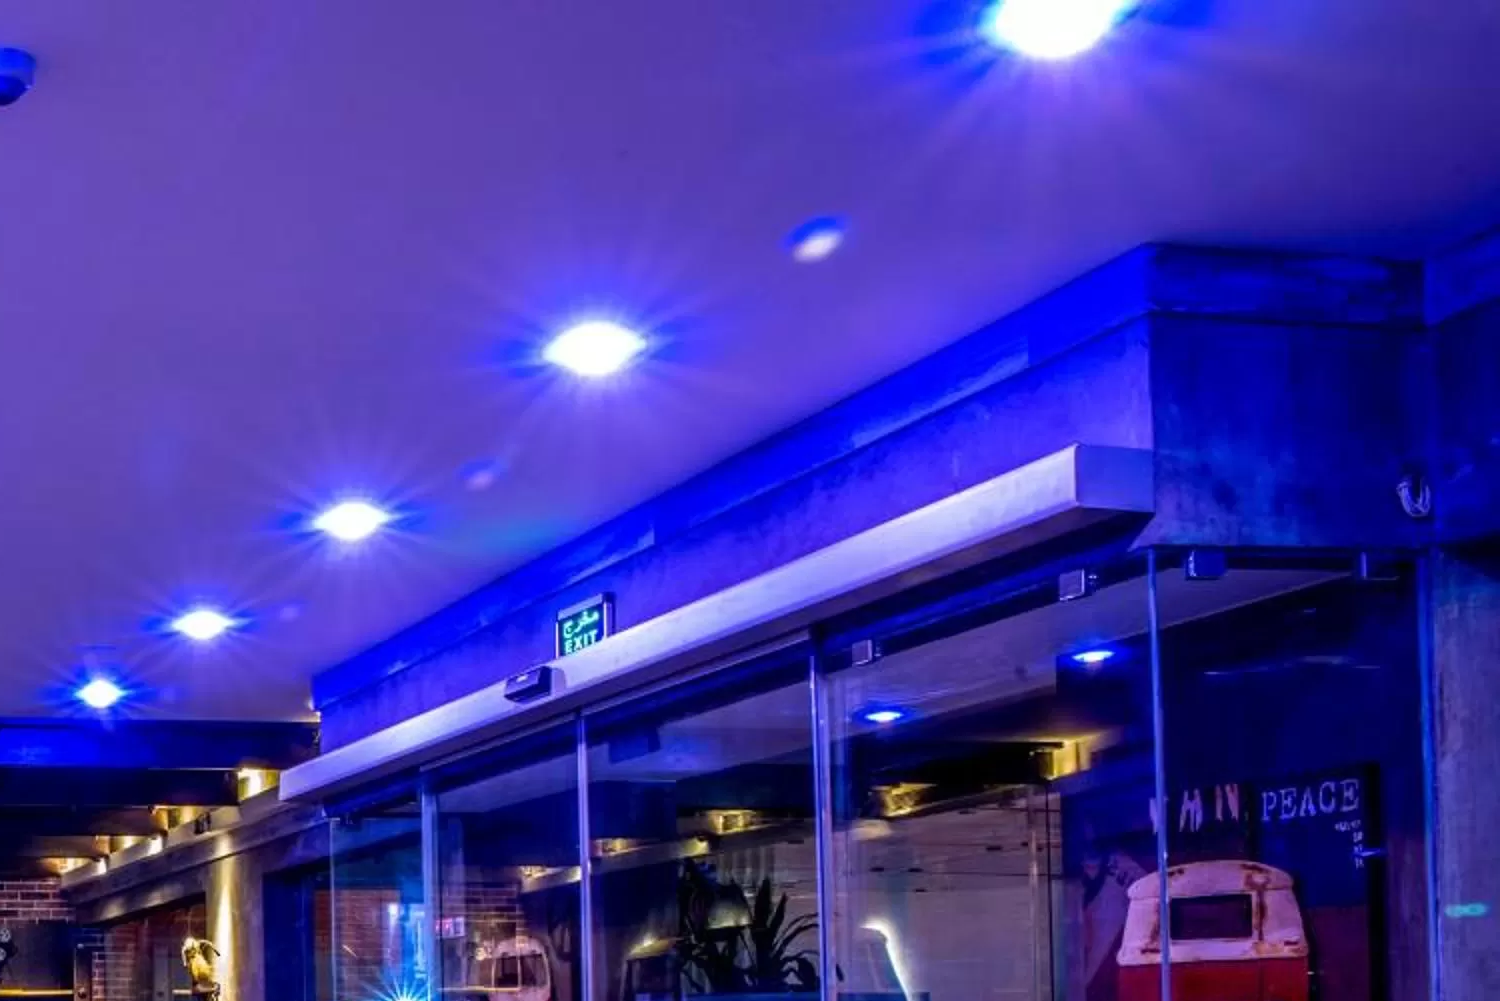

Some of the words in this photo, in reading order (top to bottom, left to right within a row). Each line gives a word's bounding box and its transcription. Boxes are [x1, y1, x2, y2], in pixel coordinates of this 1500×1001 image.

[563, 609, 599, 638] مخرج
[564, 629, 598, 653] EXIT
[1261, 778, 1360, 822] PEACE
